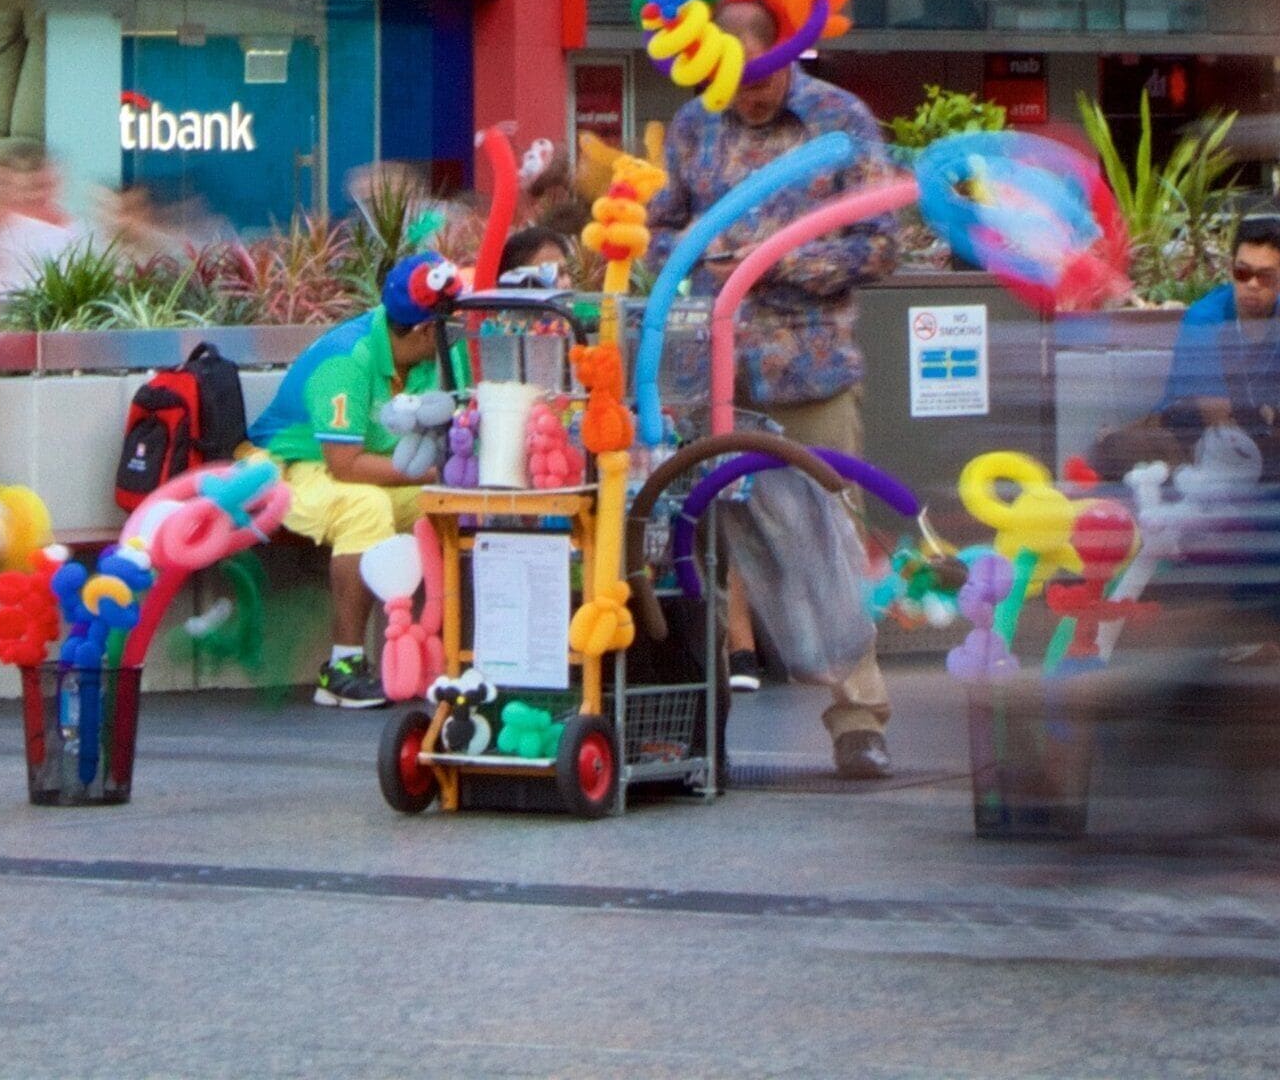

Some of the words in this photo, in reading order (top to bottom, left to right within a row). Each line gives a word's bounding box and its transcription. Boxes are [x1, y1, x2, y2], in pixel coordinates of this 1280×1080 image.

[120, 101, 256, 152] tibank
[953, 313, 969, 324] NO
[939, 325, 983, 337] SMOKING
[331, 392, 350, 429] 1
